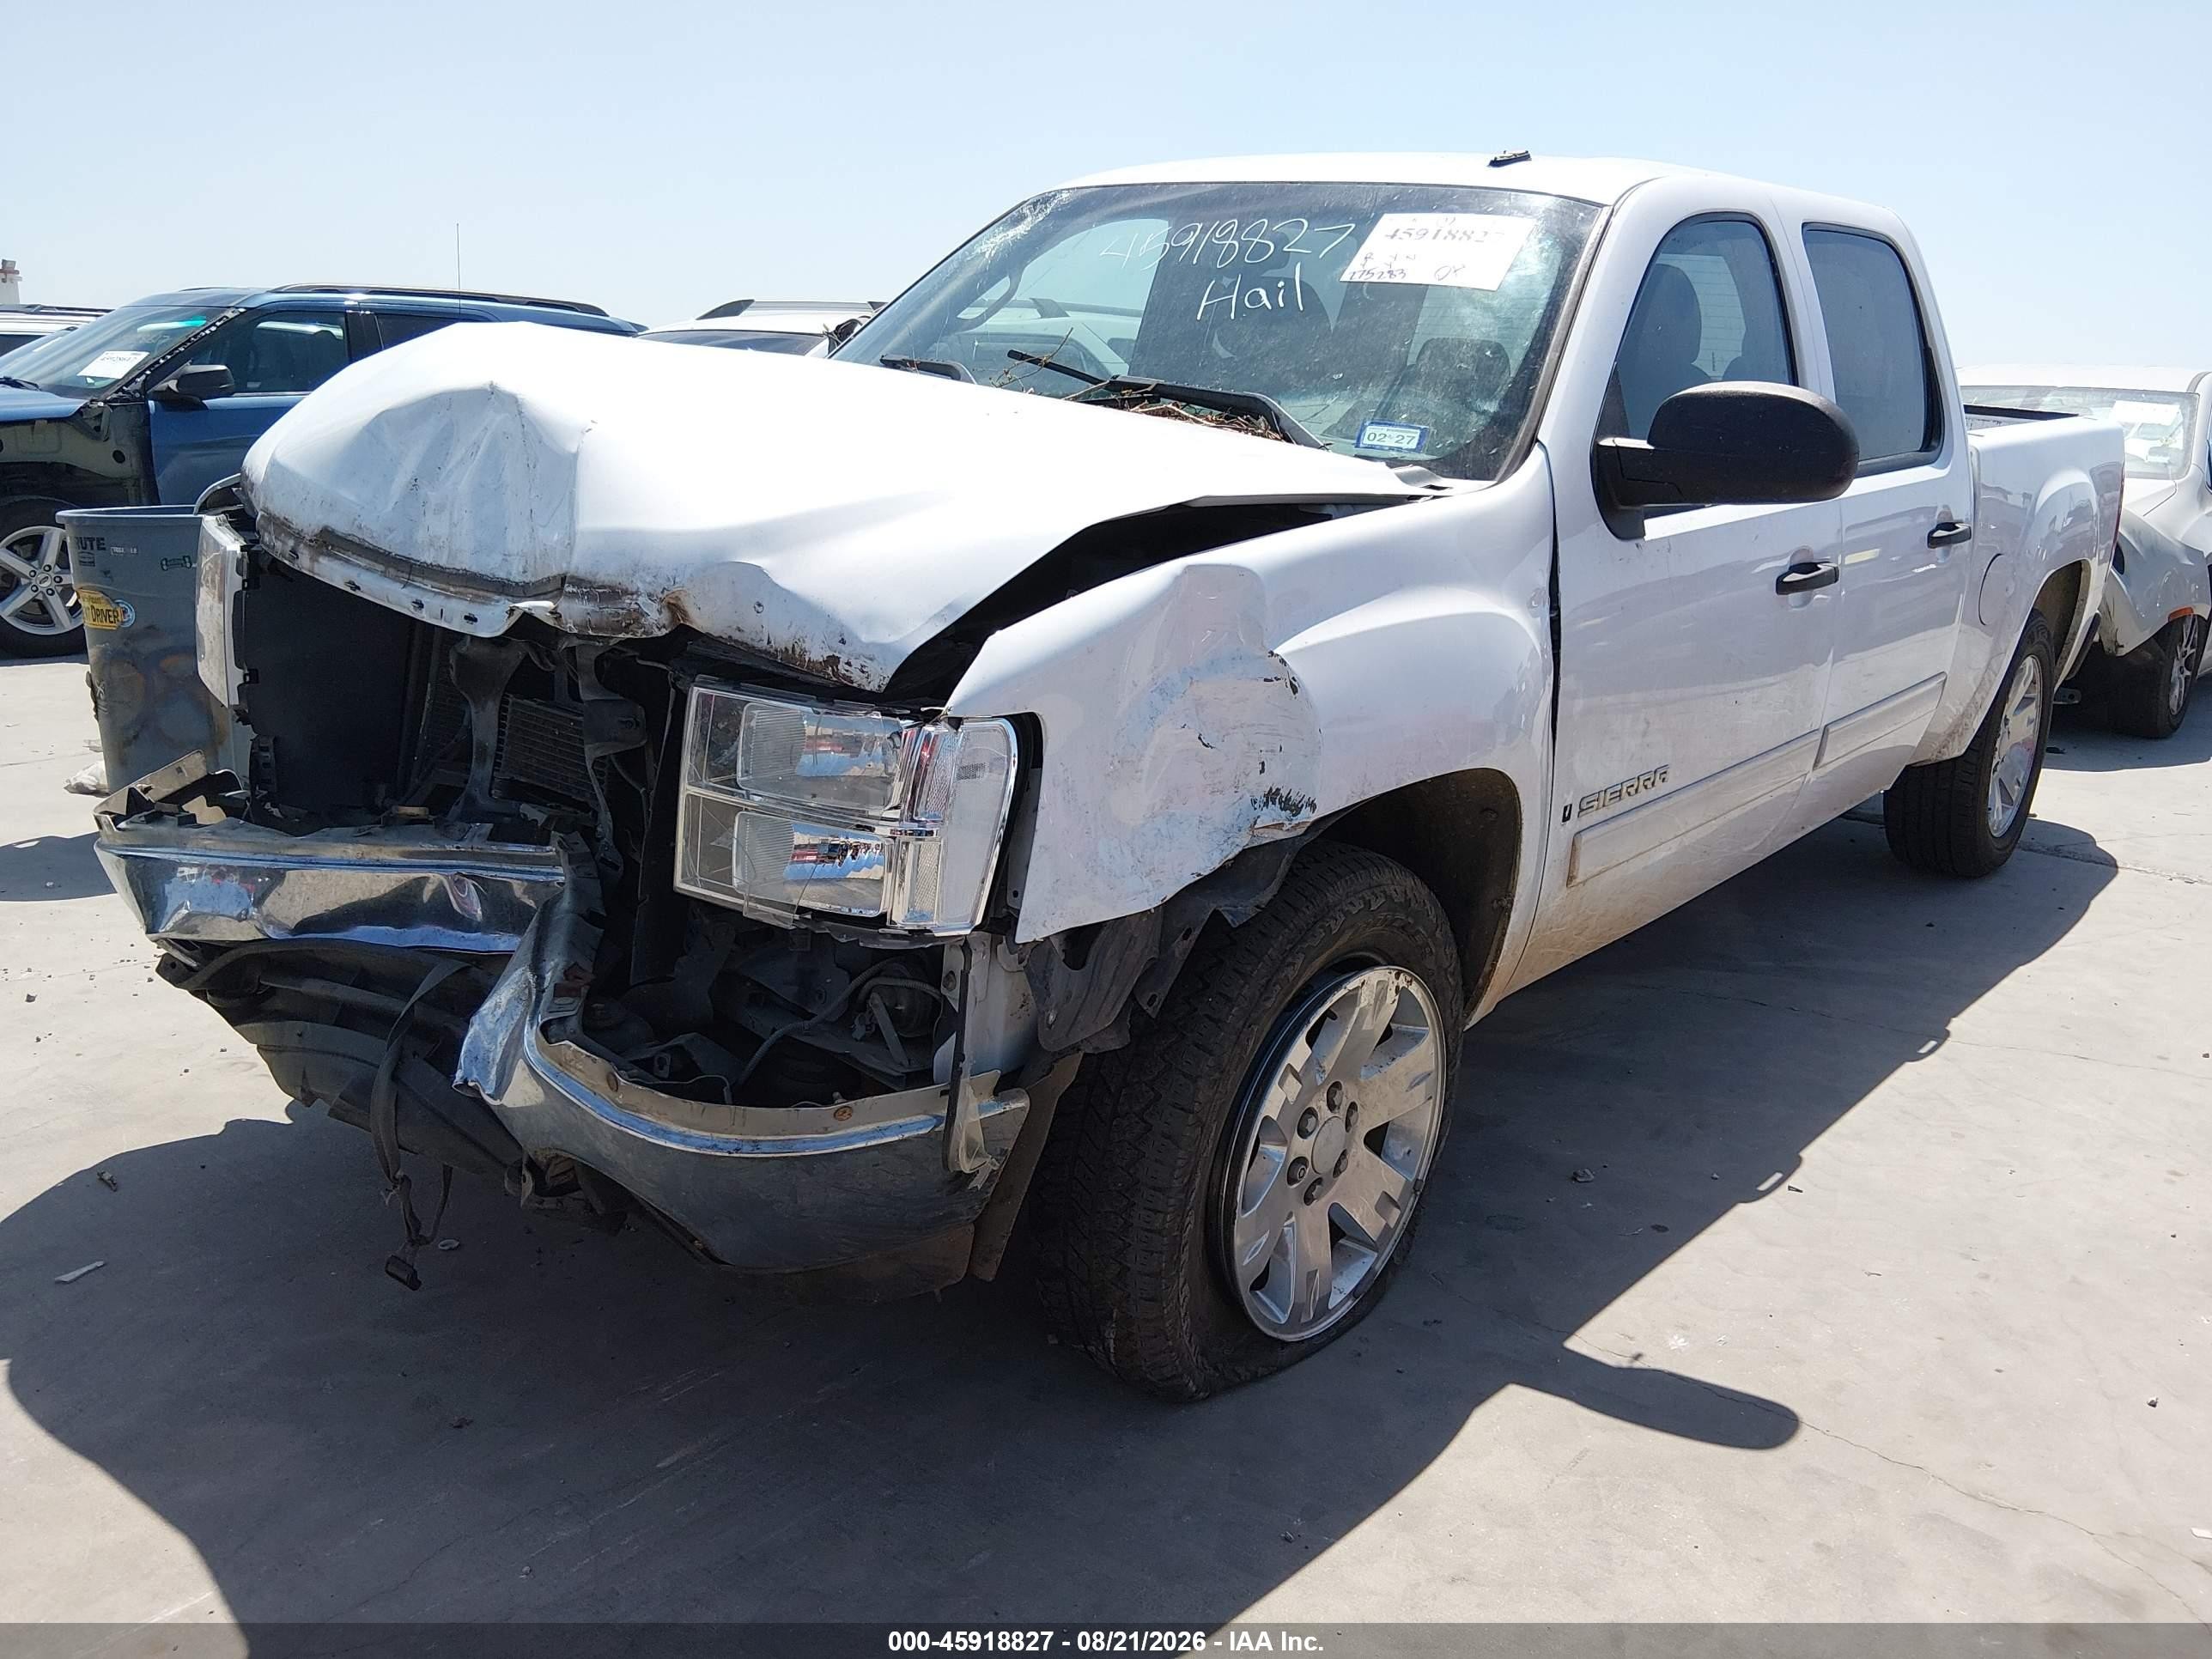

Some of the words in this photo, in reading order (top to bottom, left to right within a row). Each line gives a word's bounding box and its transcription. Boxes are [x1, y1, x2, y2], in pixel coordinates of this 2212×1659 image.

[1100, 218, 1356, 270] 45918827
[1196, 261, 1304, 321] Hail
[1367, 432, 1388, 442] 02
[1394, 434, 1416, 446] 27
[1577, 764, 1670, 818] SIERRA
